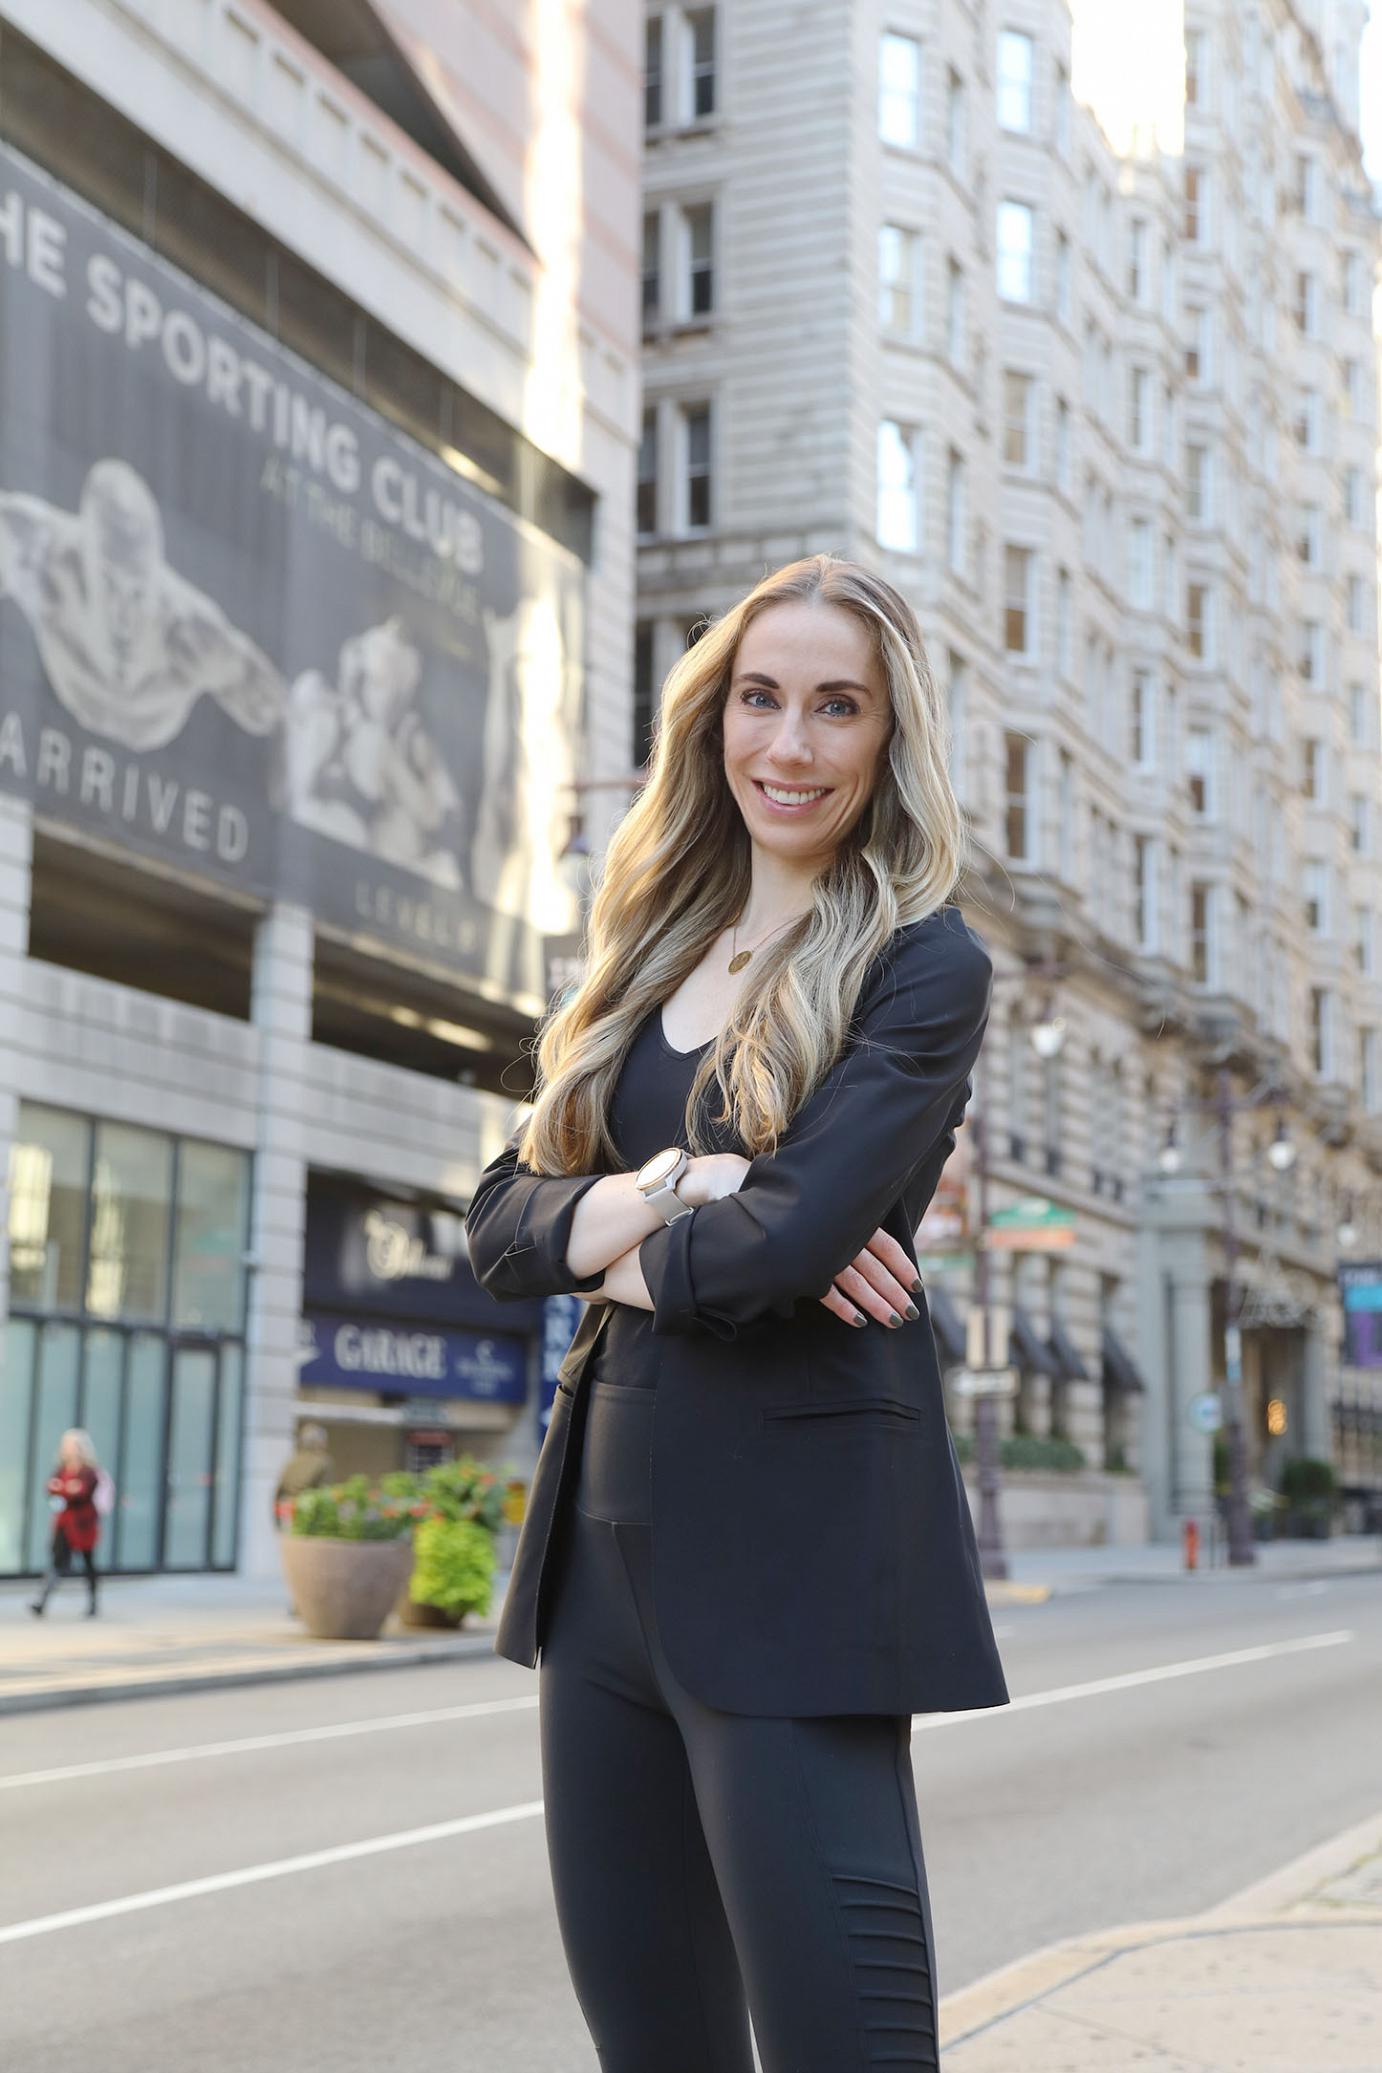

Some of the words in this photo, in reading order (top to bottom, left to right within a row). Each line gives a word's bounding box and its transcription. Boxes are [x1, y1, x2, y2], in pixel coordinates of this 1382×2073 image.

[86, 254, 360, 494] SPORTING
[371, 456, 484, 575] CLUB
[0, 711, 249, 863] ARRIVED
